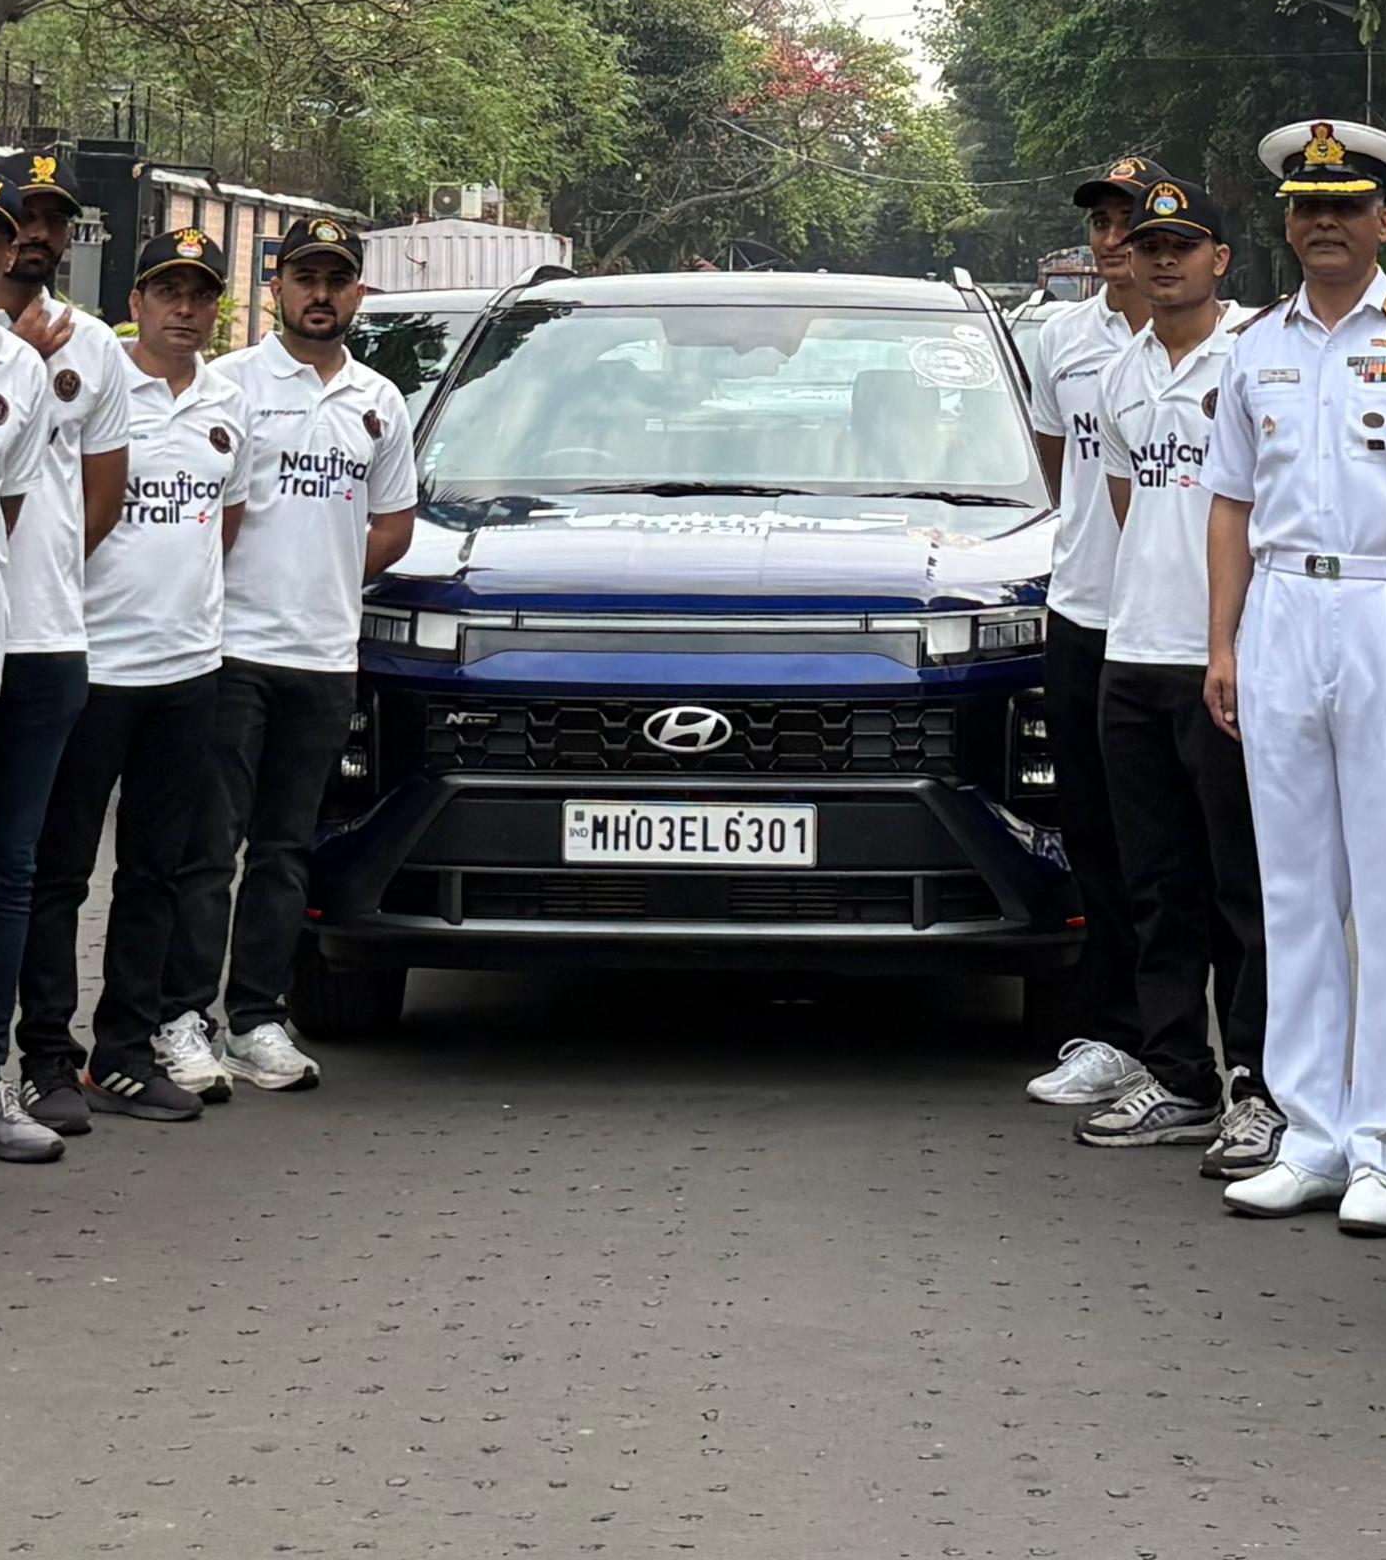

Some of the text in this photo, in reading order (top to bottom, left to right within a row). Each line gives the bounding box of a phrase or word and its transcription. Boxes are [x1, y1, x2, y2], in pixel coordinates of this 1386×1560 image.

[279, 474, 330, 498] Trail
[124, 500, 180, 523] Trail
[591, 814, 807, 854] MH03EL6301
